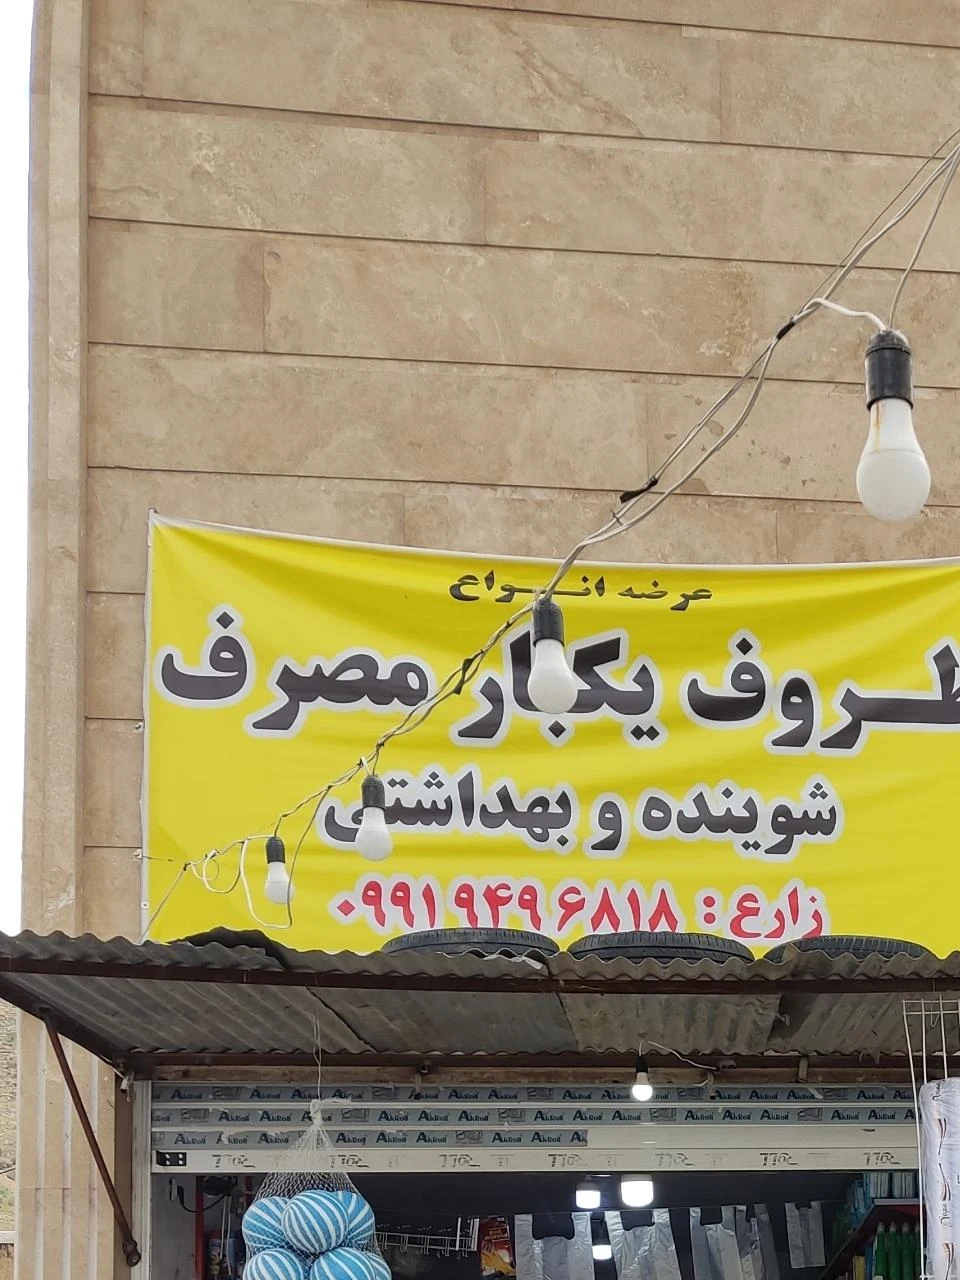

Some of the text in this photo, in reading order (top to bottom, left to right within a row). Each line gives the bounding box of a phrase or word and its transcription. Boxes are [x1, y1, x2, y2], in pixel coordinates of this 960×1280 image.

[449, 569, 713, 612] عرضه انواع
[160, 610, 430, 732] مصرف
[456, 630, 661, 743] یکبار
[323, 770, 838, 856] شوینده و بهداشتی
